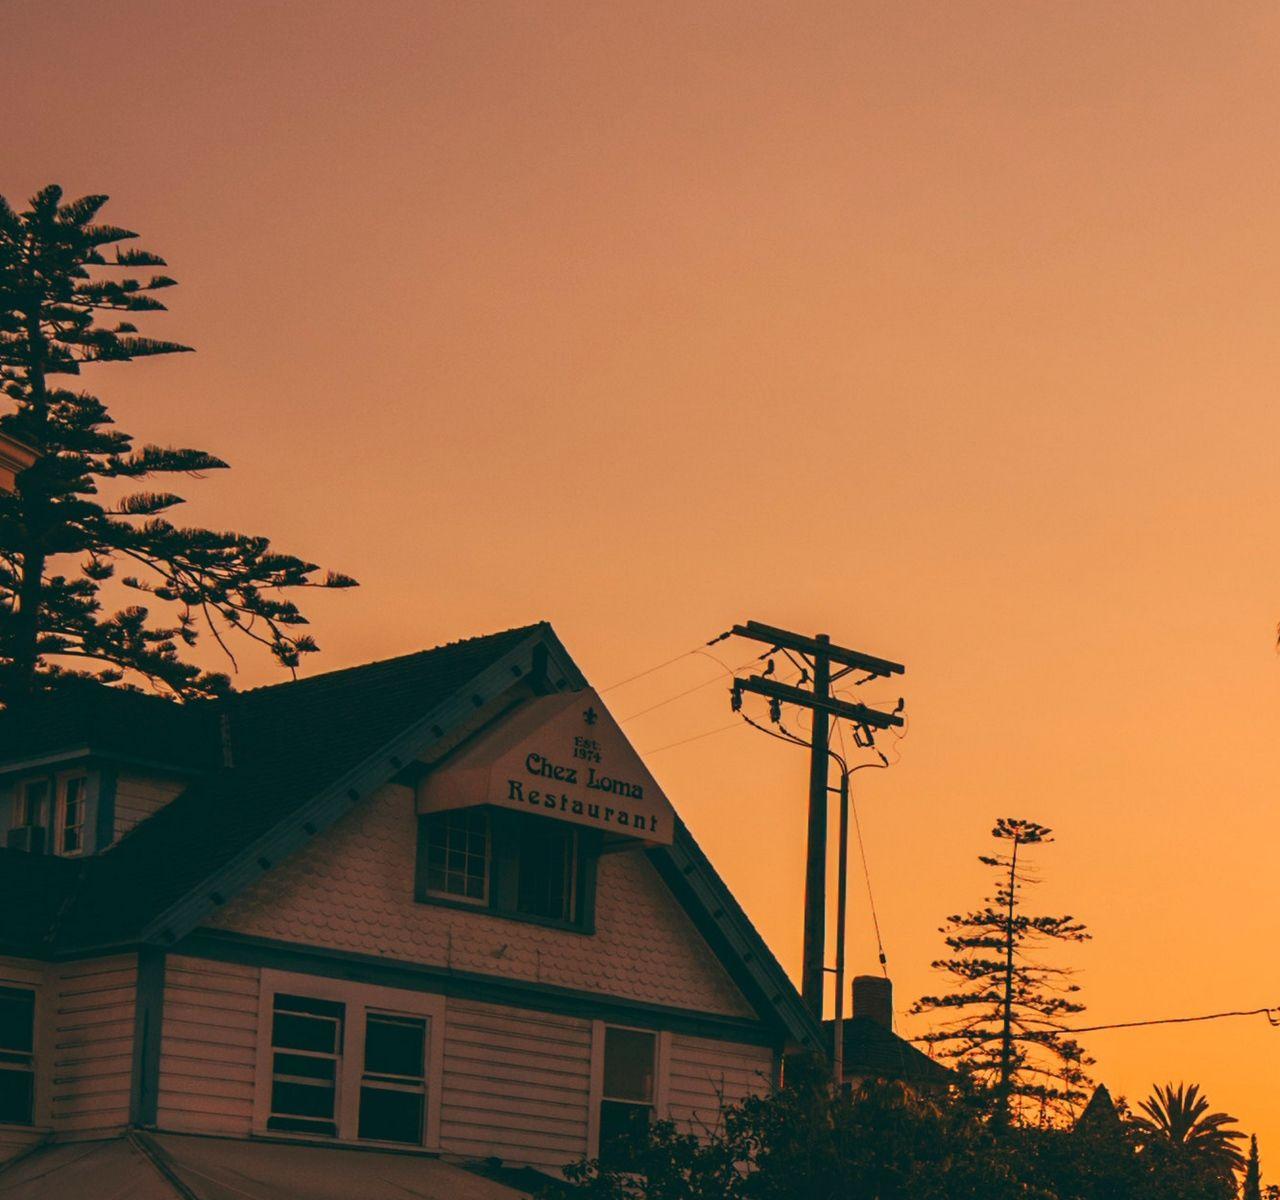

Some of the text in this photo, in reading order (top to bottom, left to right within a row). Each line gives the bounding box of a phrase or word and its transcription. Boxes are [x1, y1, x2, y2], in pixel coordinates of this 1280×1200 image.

[525, 753, 643, 799] Chez Loma
[574, 748, 601, 763] 1974
[508, 780, 658, 831] Restaurant
